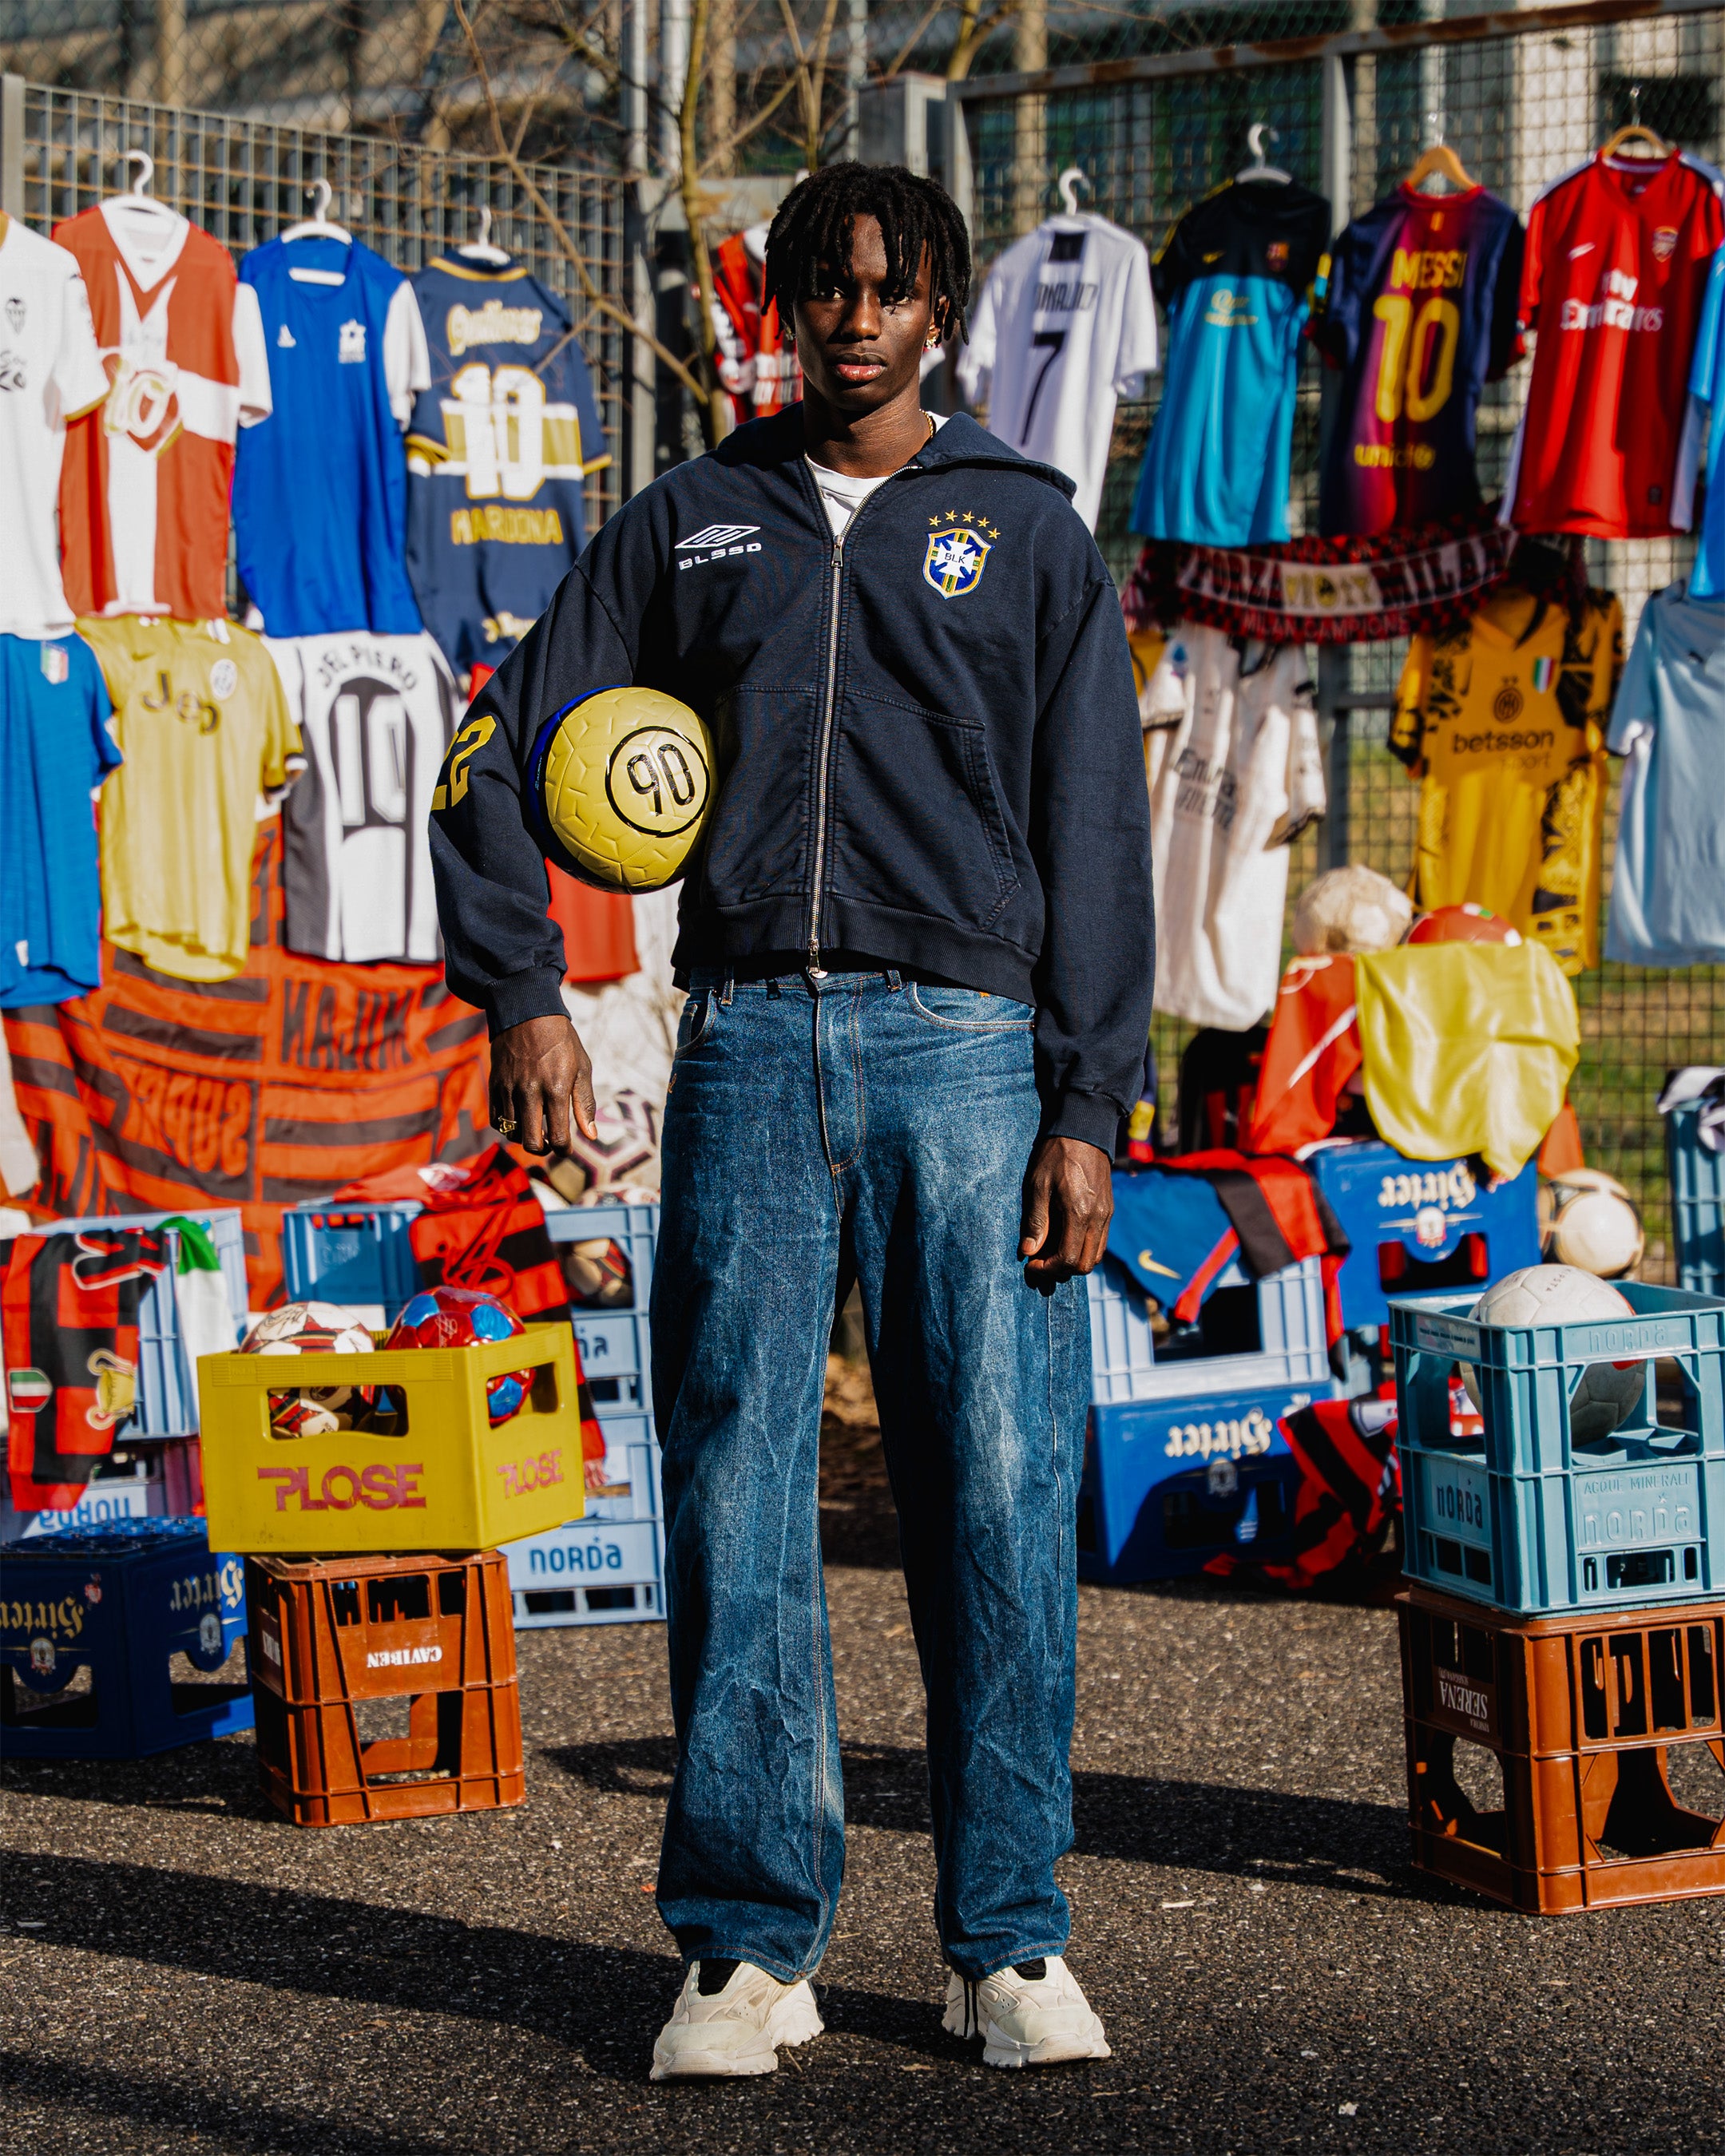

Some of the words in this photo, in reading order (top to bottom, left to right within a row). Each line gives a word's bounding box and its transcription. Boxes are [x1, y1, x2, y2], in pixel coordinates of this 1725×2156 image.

[1390, 248, 1467, 289] MESSI
[1373, 295, 1460, 422] 10
[1021, 331, 1068, 446] 7
[450, 362, 545, 501] 10
[679, 541, 762, 572] BLSSD
[943, 552, 966, 565] BLK
[431, 715, 497, 810] 2
[1453, 728, 1555, 755] betsson
[627, 743, 695, 817] 90
[257, 1463, 427, 1512] PLOSE
[498, 1449, 565, 1500] PLOSE
[1583, 1477, 1624, 1495] ACQUE
[1630, 1472, 1691, 1492] MINERALI
[1439, 1680, 1488, 1720] SERENA
